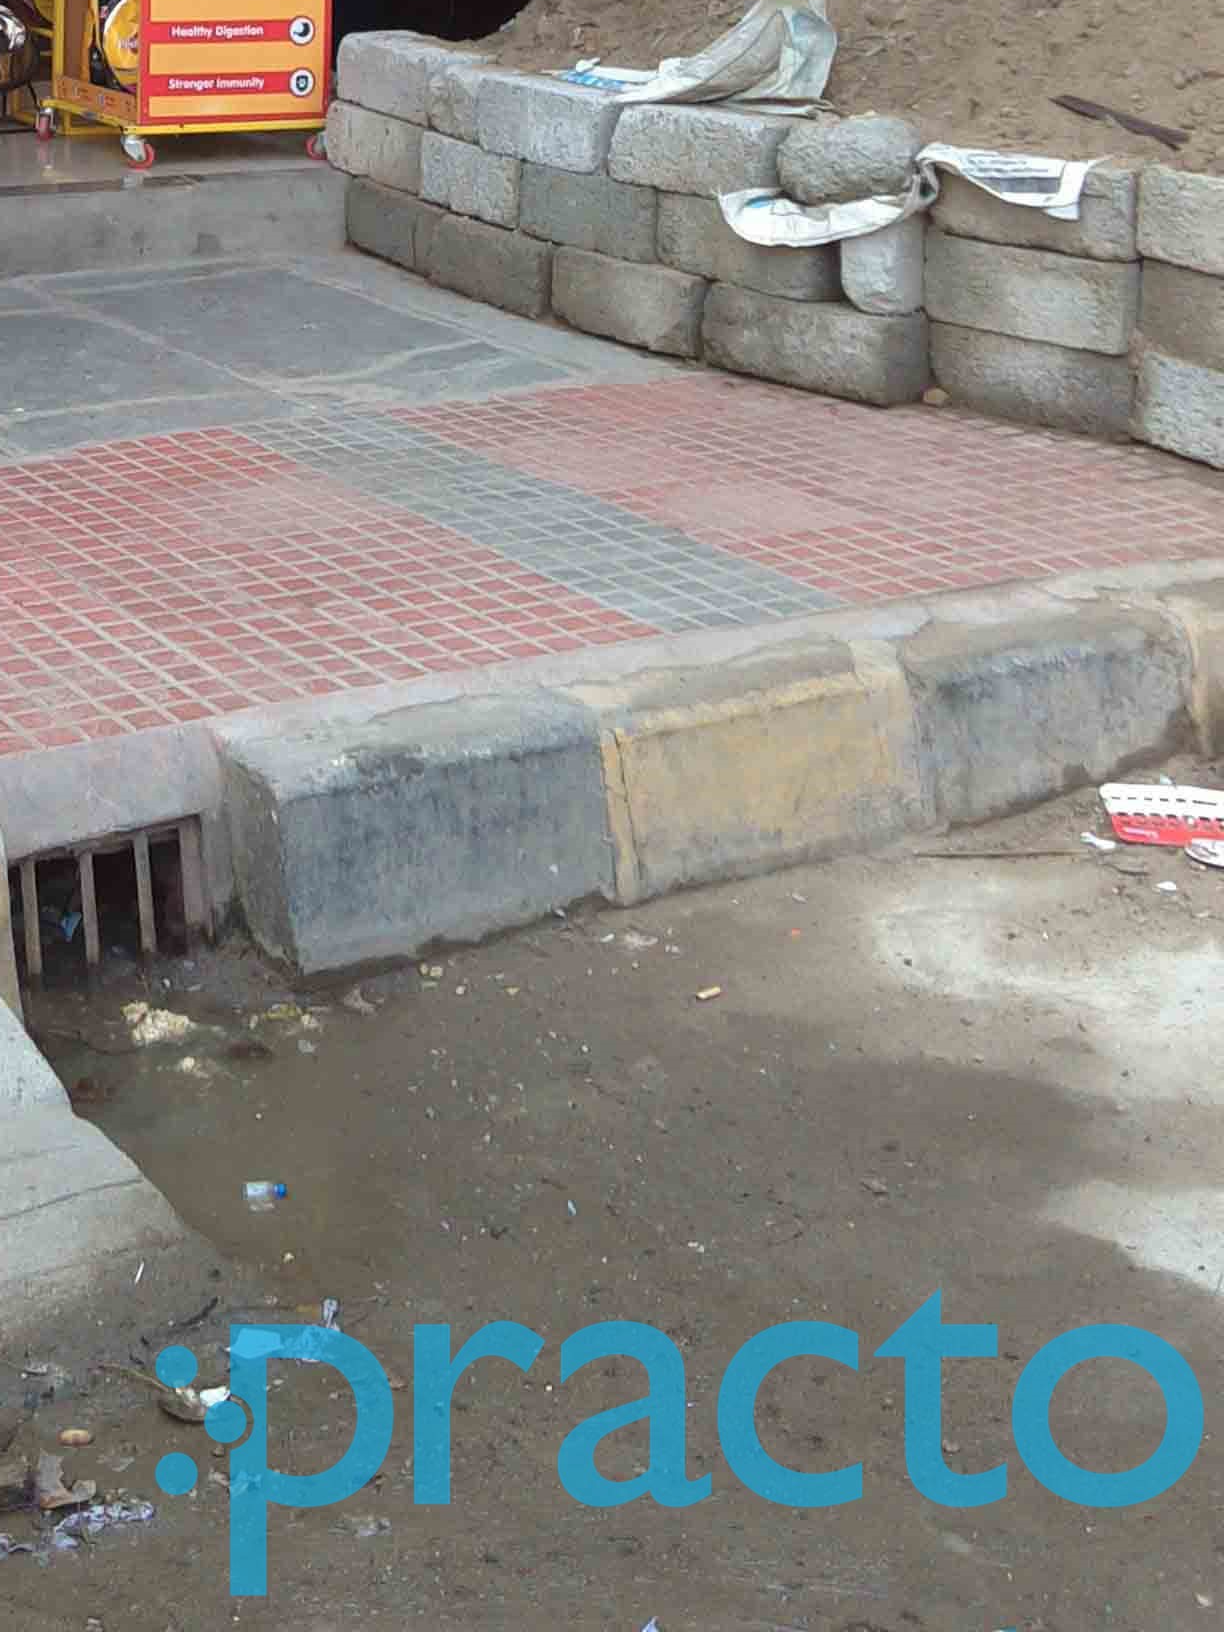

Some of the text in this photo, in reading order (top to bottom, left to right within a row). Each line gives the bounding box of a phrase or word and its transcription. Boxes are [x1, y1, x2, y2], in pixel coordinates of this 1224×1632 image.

[171, 24, 264, 39] Healthy Digestion
[168, 77, 265, 92] Stronger Immunity
